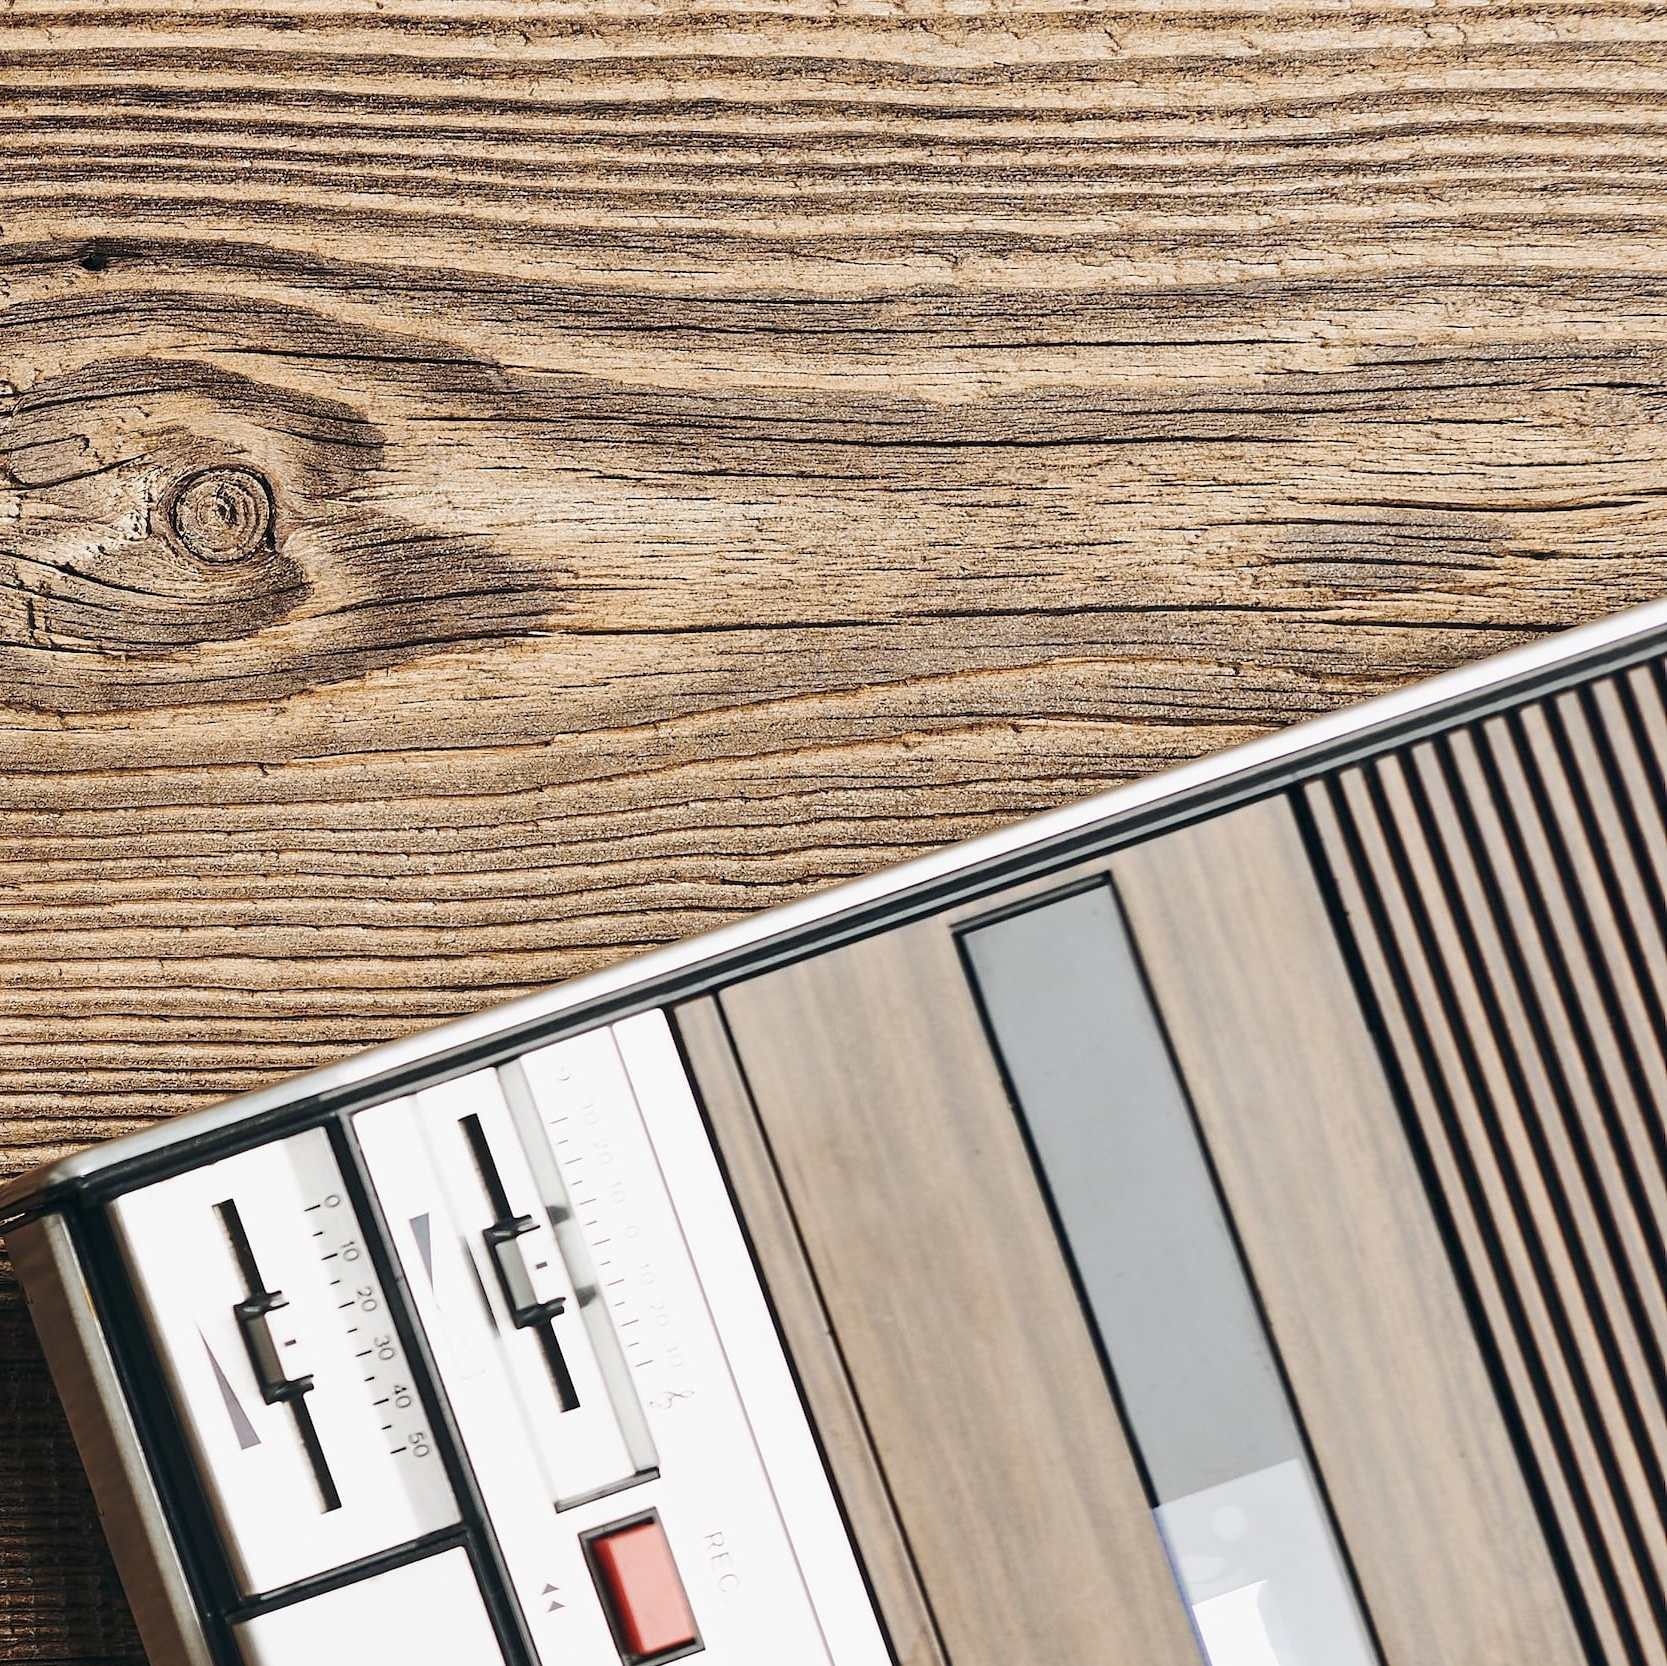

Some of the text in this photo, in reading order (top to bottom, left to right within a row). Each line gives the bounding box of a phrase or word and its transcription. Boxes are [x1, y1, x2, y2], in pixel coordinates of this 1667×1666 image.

[324, 1194, 429, 1458] 0 10 20 30 40 50
